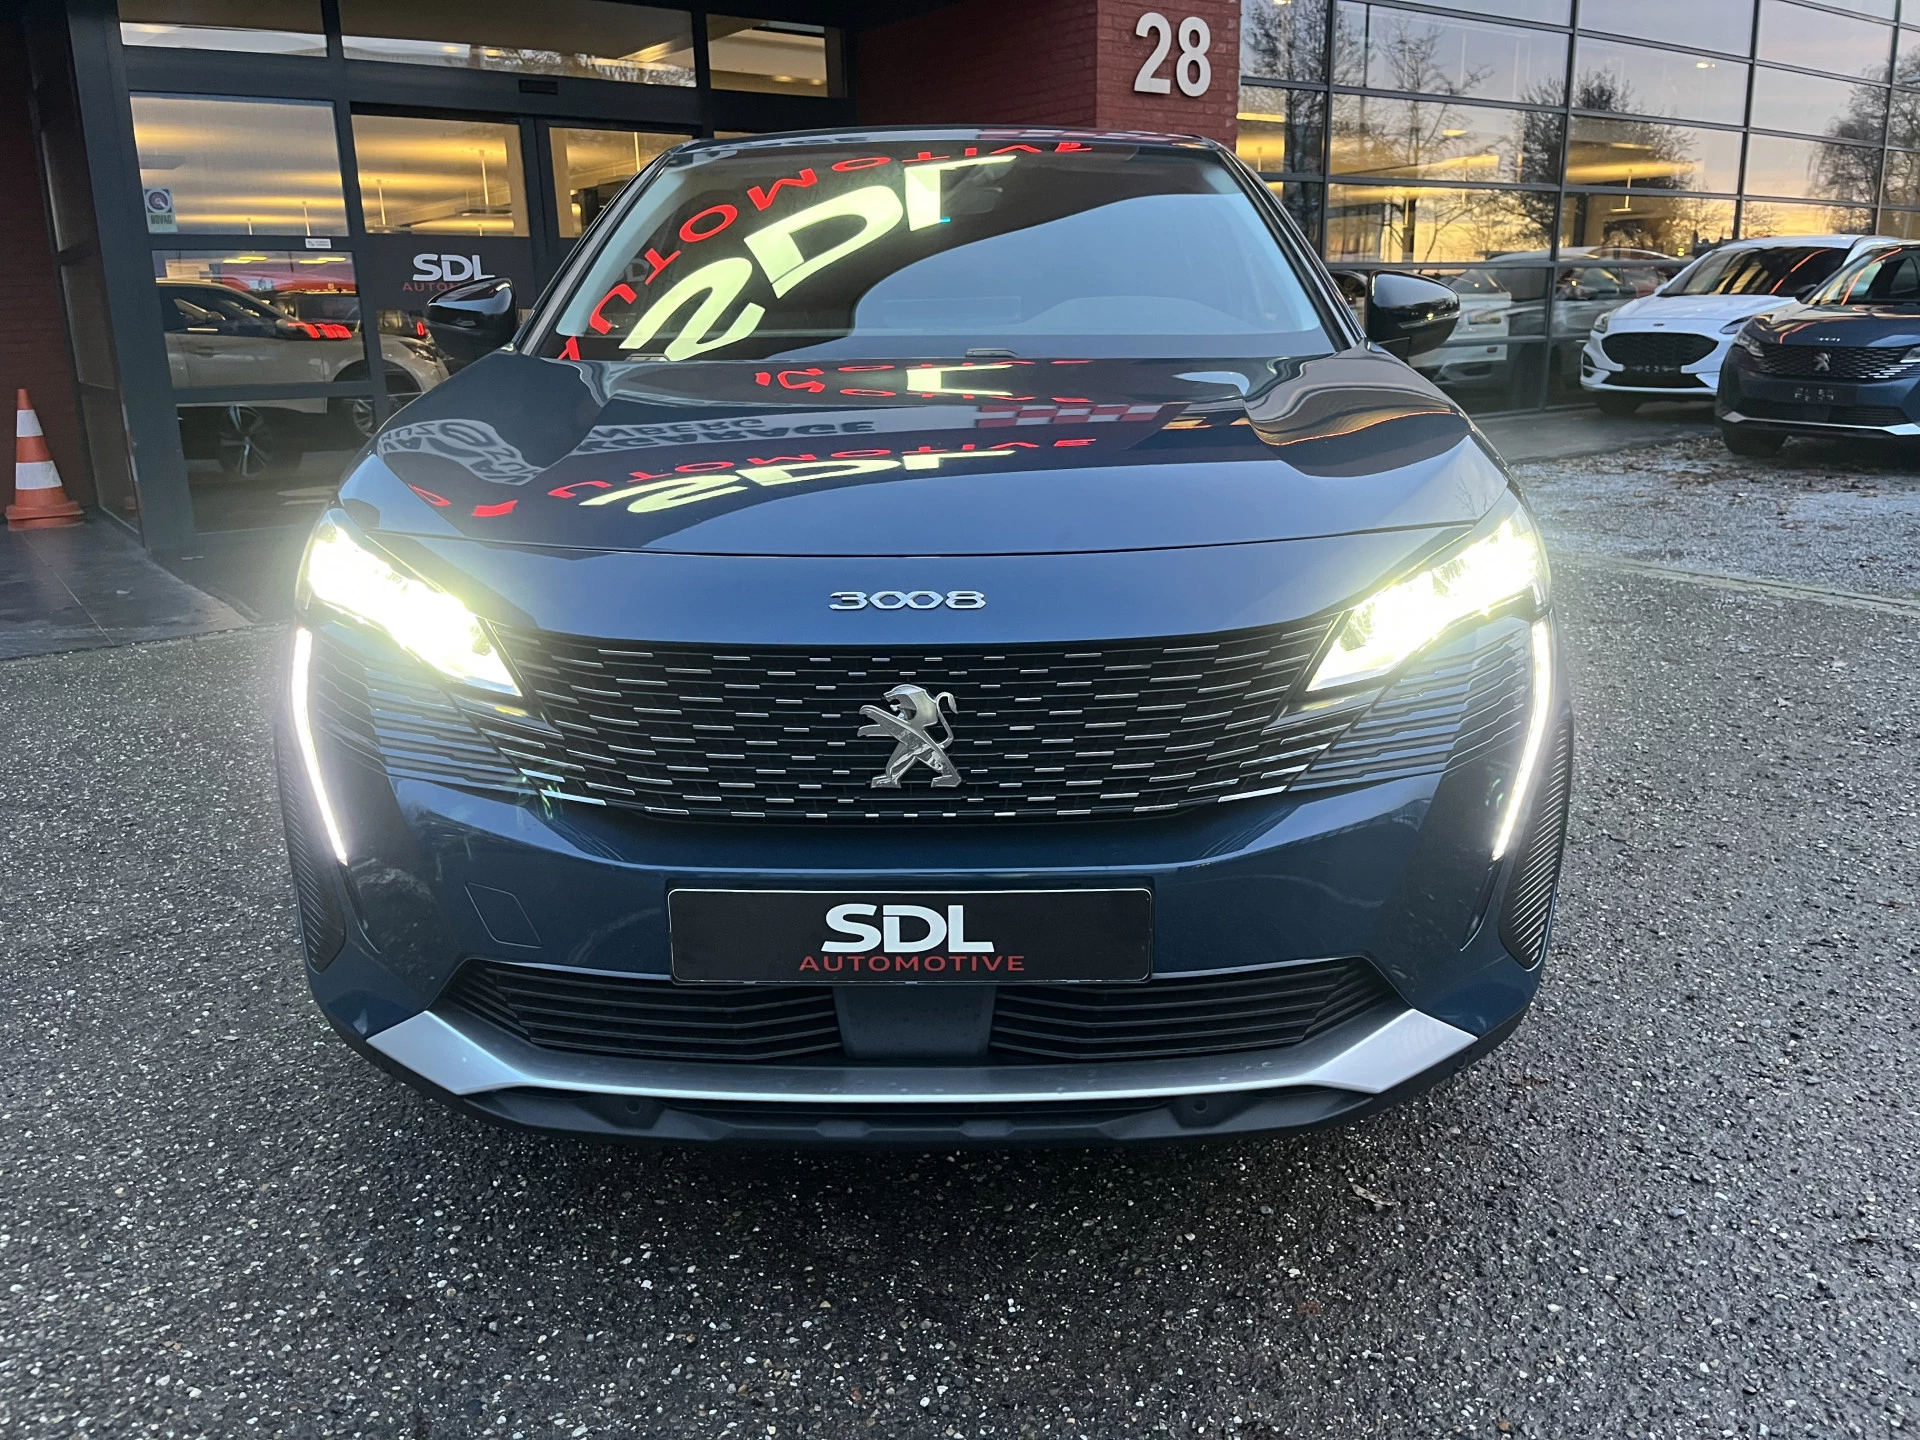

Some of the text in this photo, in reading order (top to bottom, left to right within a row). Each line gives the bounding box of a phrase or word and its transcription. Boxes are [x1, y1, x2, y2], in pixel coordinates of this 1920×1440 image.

[1134, 12, 1211, 97] 28
[412, 253, 496, 282] SDL
[829, 591, 987, 610] 3008
[821, 903, 995, 953] SDL
[799, 955, 1025, 972] AUTOMOTIVE
